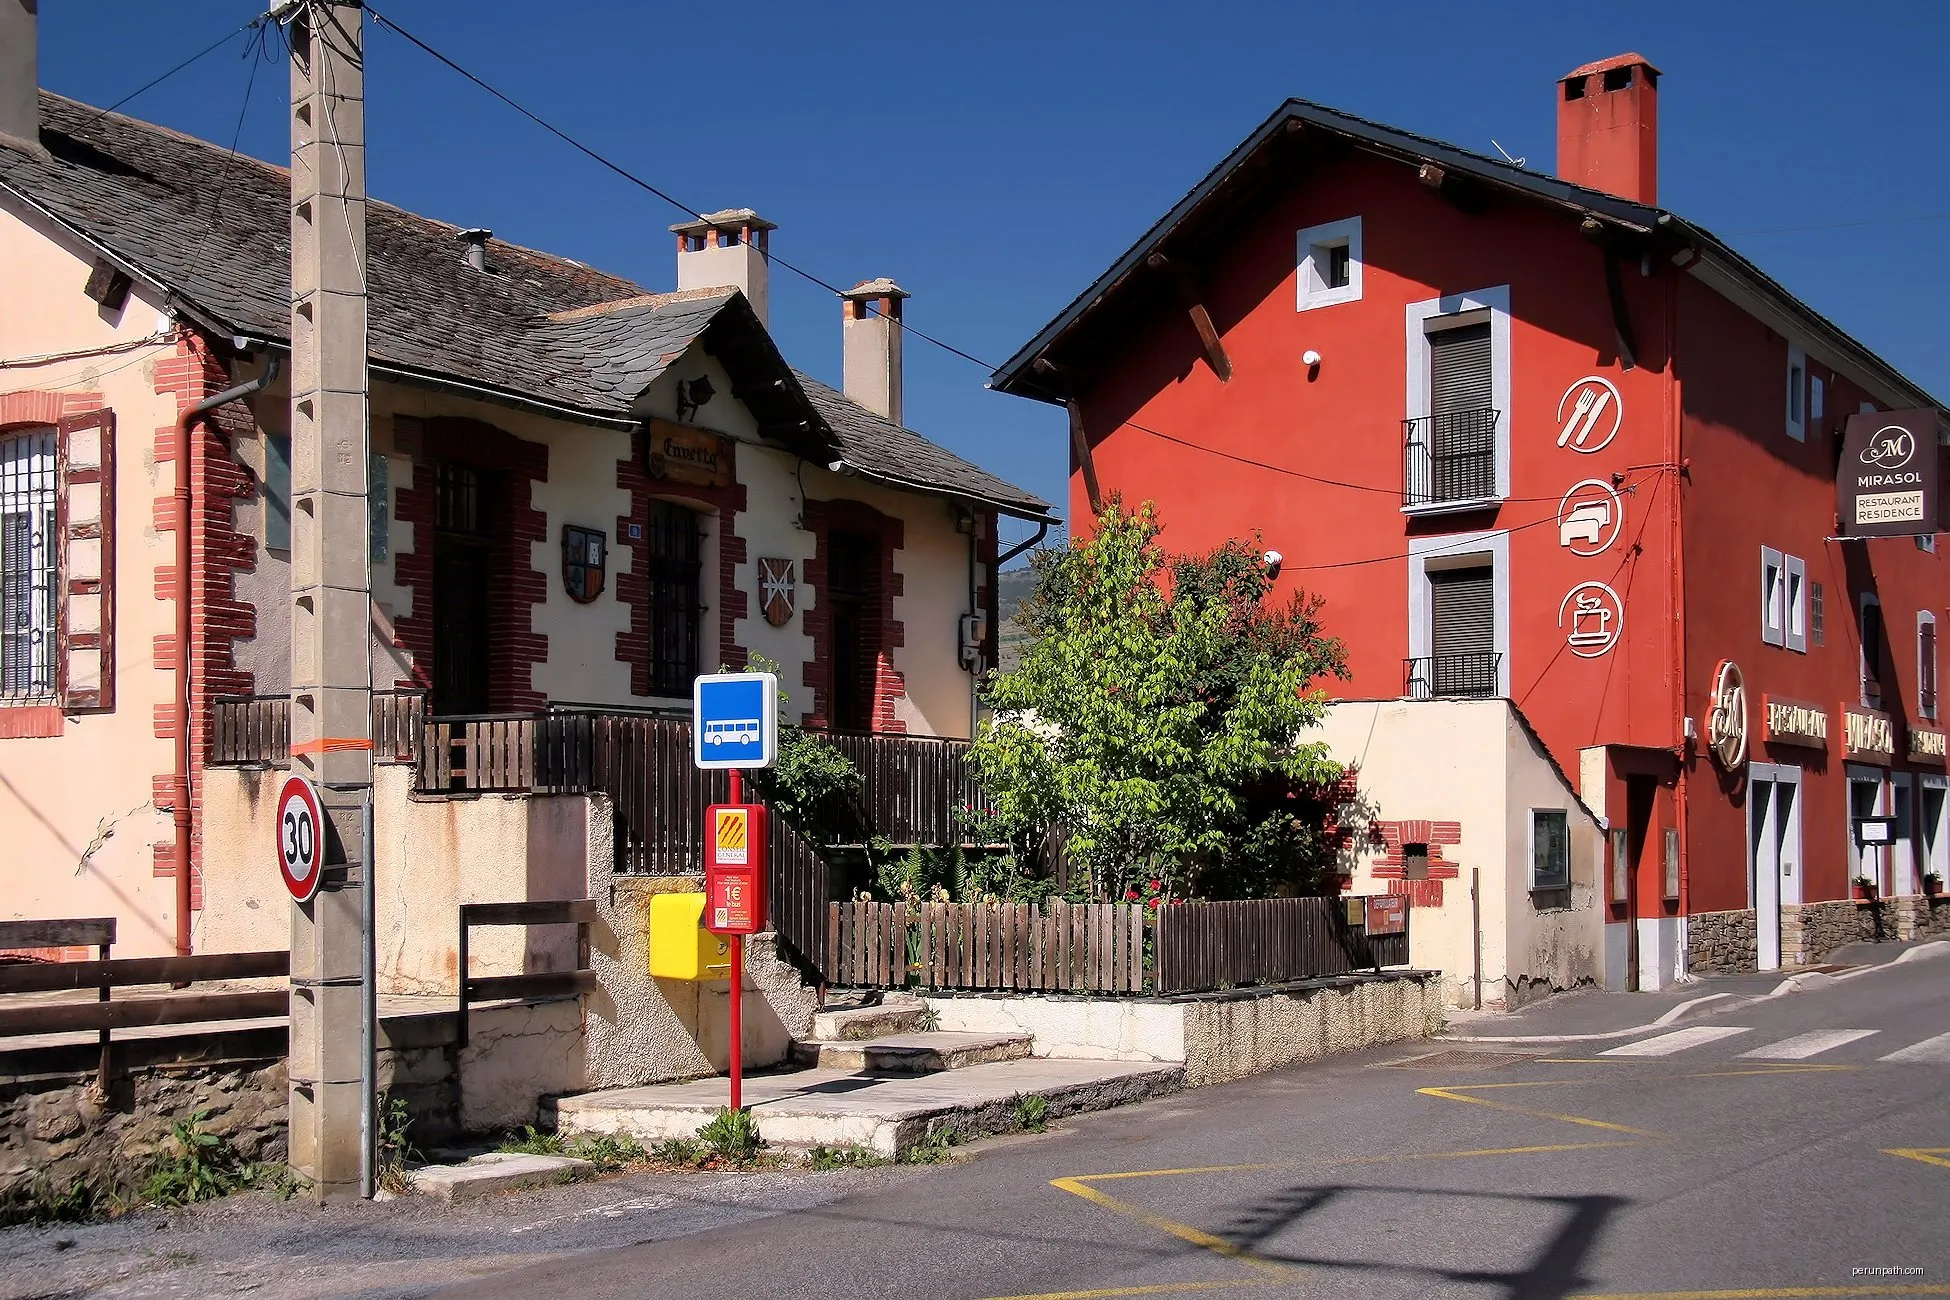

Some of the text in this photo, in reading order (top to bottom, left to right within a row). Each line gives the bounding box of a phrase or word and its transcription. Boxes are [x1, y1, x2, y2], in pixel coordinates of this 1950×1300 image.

[1857, 472, 1922, 488] MIRASOL
[1858, 495, 1921, 508] RESTAURANT
[1858, 507, 1921, 520] RESIDENCE
[1767, 703, 1828, 739] RESTAURANT
[1844, 712, 1896, 754] MIRASOL
[284, 811, 313, 865] 30
[724, 885, 742, 901] 1€
